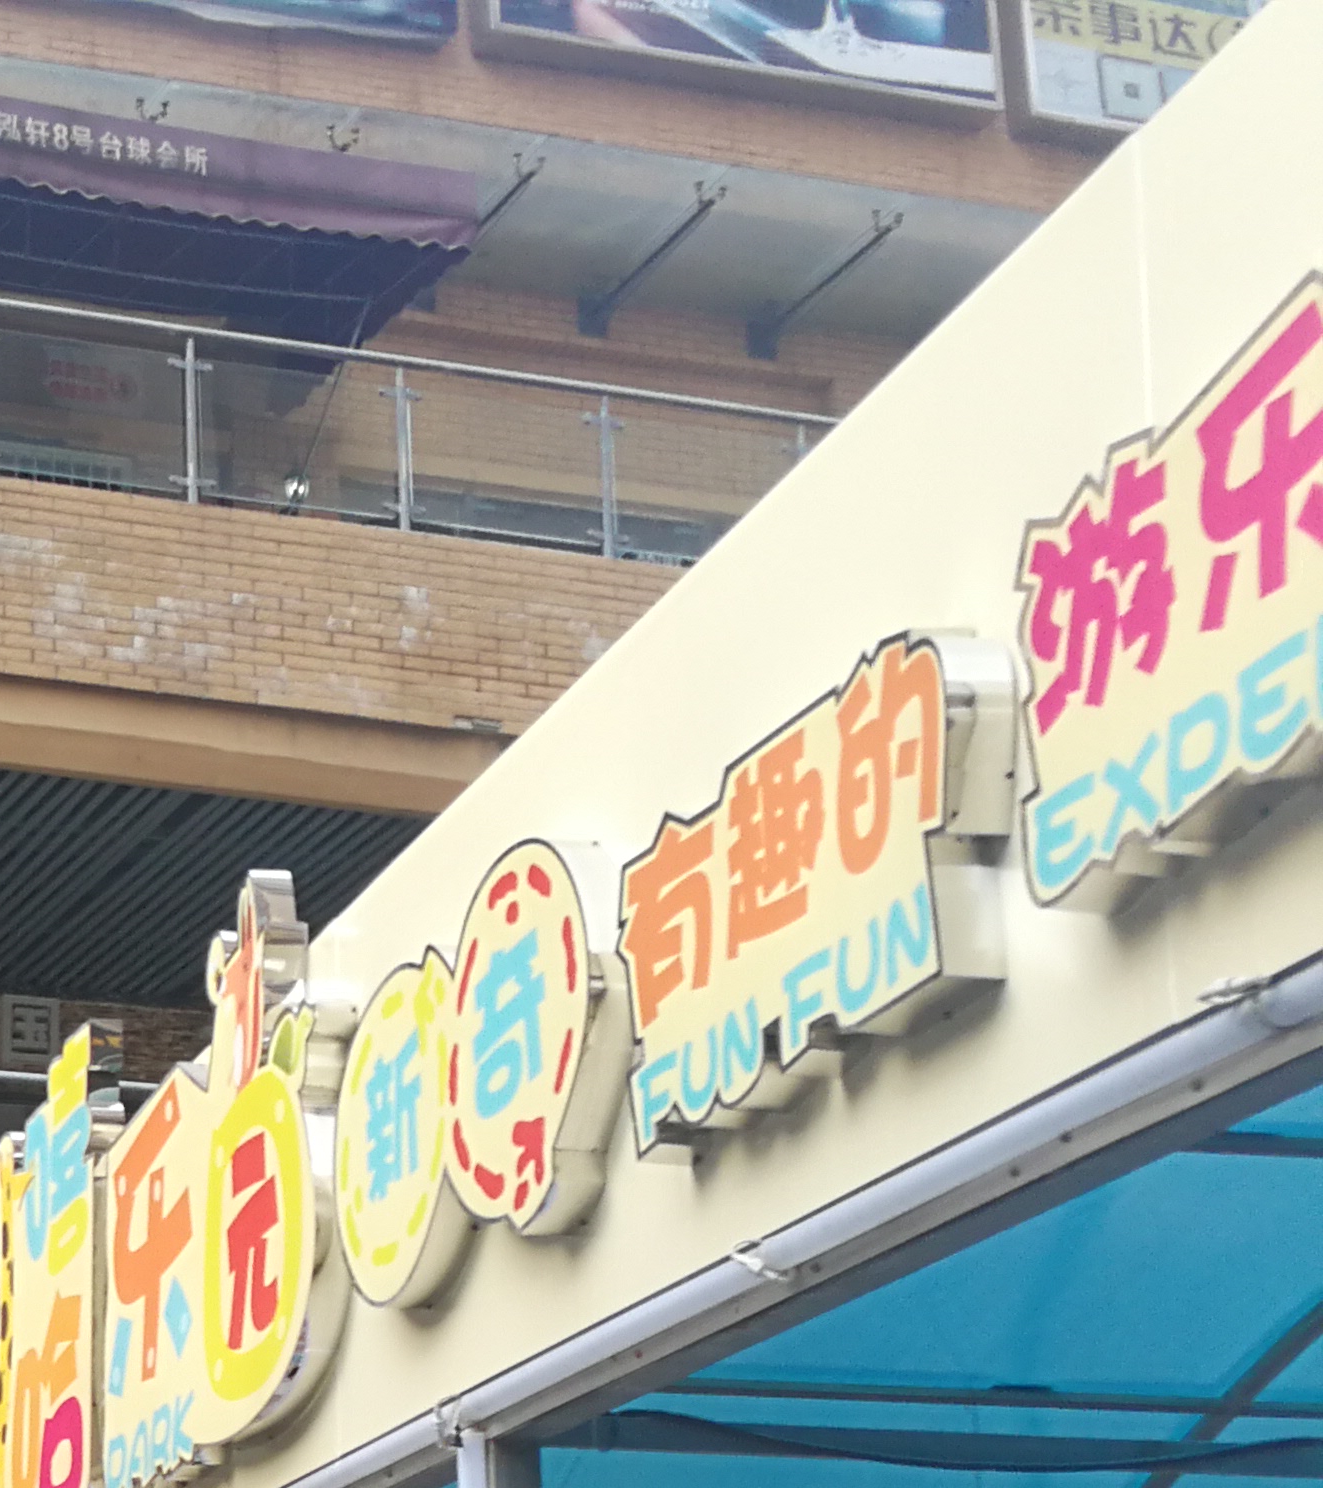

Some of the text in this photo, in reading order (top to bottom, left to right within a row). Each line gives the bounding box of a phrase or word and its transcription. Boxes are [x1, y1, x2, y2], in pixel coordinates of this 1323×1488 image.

[623, 643, 940, 1029] 有趣的
[1033, 612, 1323, 890] EXPE
[364, 929, 546, 1202] 新奇
[636, 884, 931, 1142] FUN FUN
